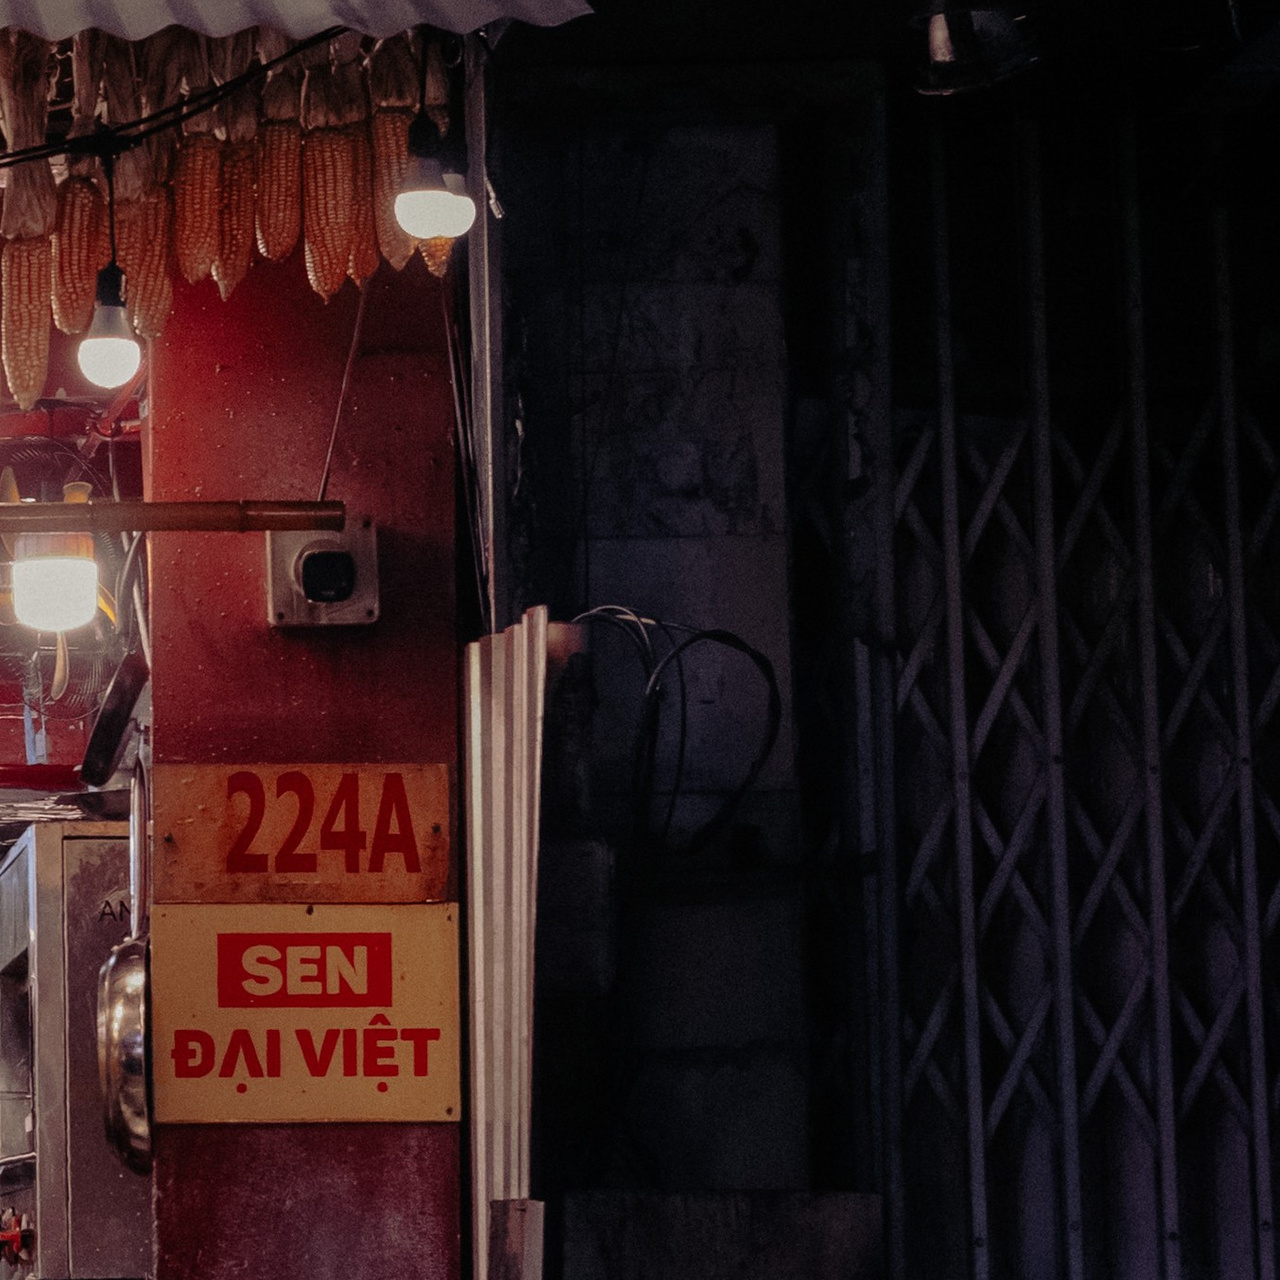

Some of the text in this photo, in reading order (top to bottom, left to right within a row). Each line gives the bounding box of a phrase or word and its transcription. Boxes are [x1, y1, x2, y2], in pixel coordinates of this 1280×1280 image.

[225, 771, 422, 874] 224A
[240, 944, 368, 996] SEN
[170, 1013, 441, 1094] ĐẠI VIỆT
